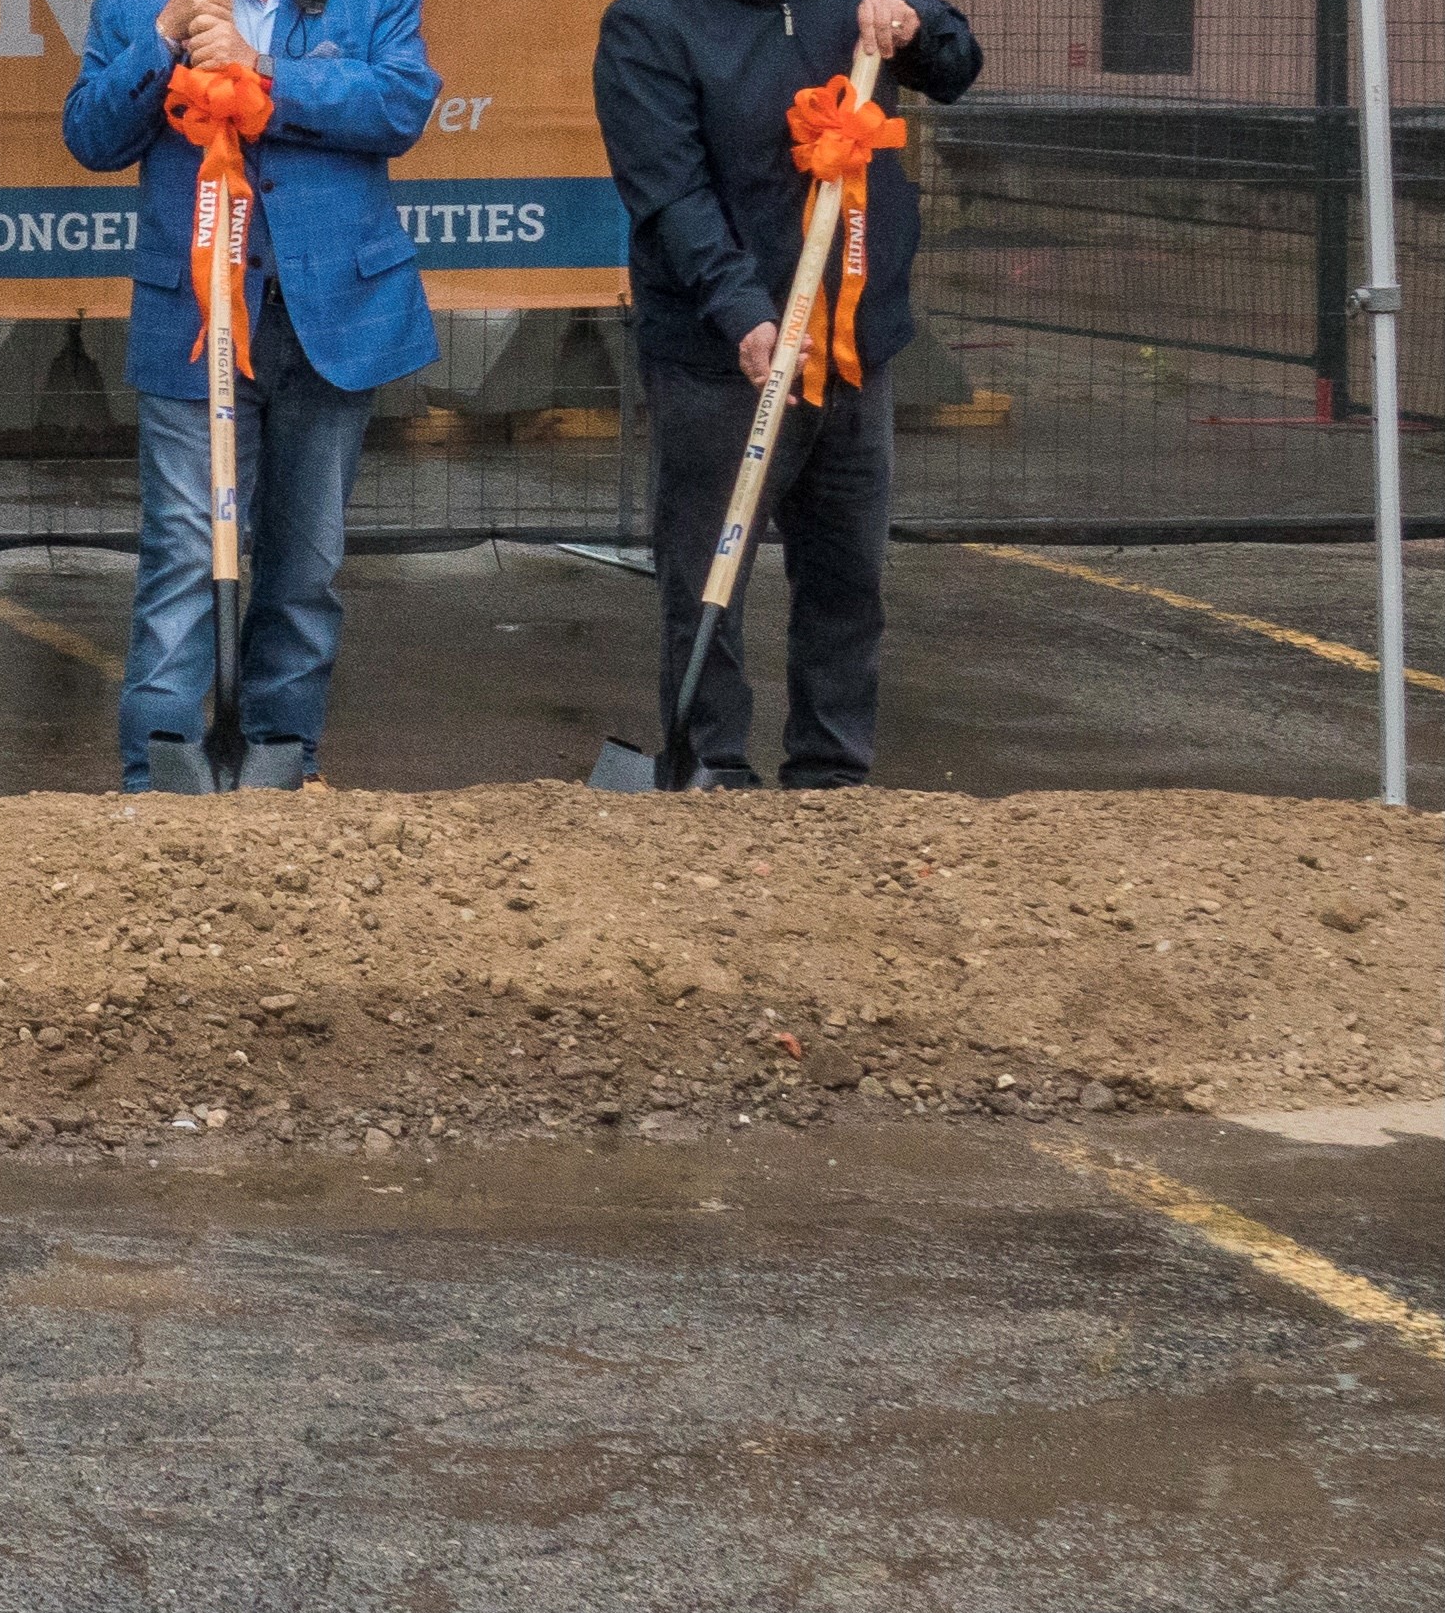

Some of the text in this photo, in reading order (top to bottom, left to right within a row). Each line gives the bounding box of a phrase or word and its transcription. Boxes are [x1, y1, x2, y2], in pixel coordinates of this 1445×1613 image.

[197, 180, 217, 248] LiUNA!
[847, 208, 865, 275] LiUNA!
[783, 294, 809, 348] LiUNA!
[217, 326, 230, 396] FENGATE
[752, 369, 784, 435] FENGATE
